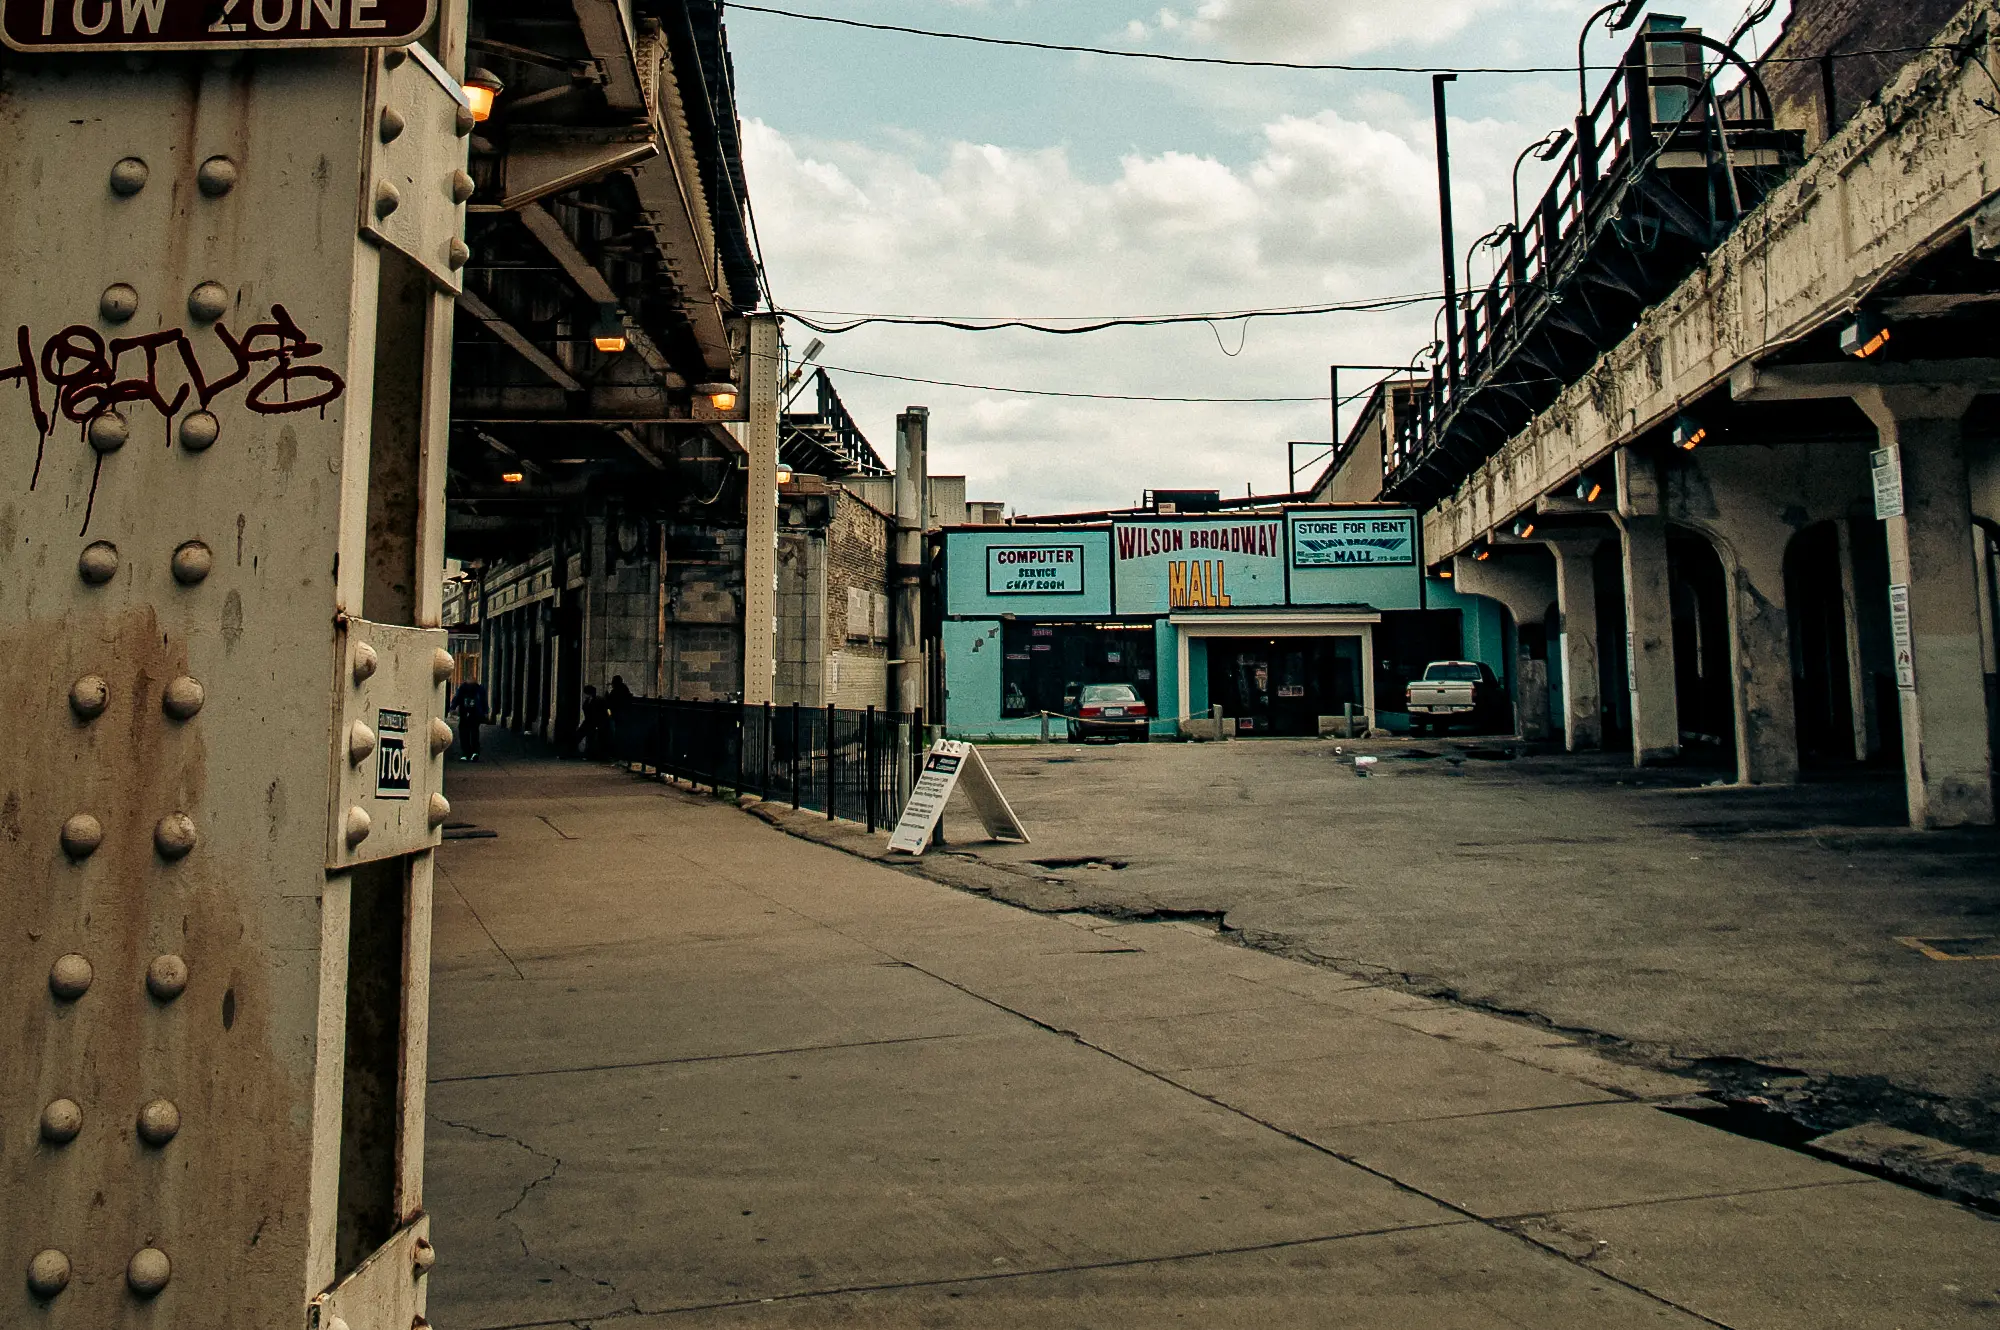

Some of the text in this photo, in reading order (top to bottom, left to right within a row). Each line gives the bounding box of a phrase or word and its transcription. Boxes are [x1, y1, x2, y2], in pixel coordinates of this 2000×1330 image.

[207, 0, 387, 32] ZONE
[1298, 521, 1406, 534] STORE FOR RENT
[1117, 523, 1278, 560] WILSON BROADWAY
[997, 550, 1074, 564] COMPUTER
[1334, 550, 1373, 563] MALL
[1018, 568, 1057, 578] SERVICE
[1036, 580, 1065, 590] ROOM
[1168, 560, 1231, 608] MALL
